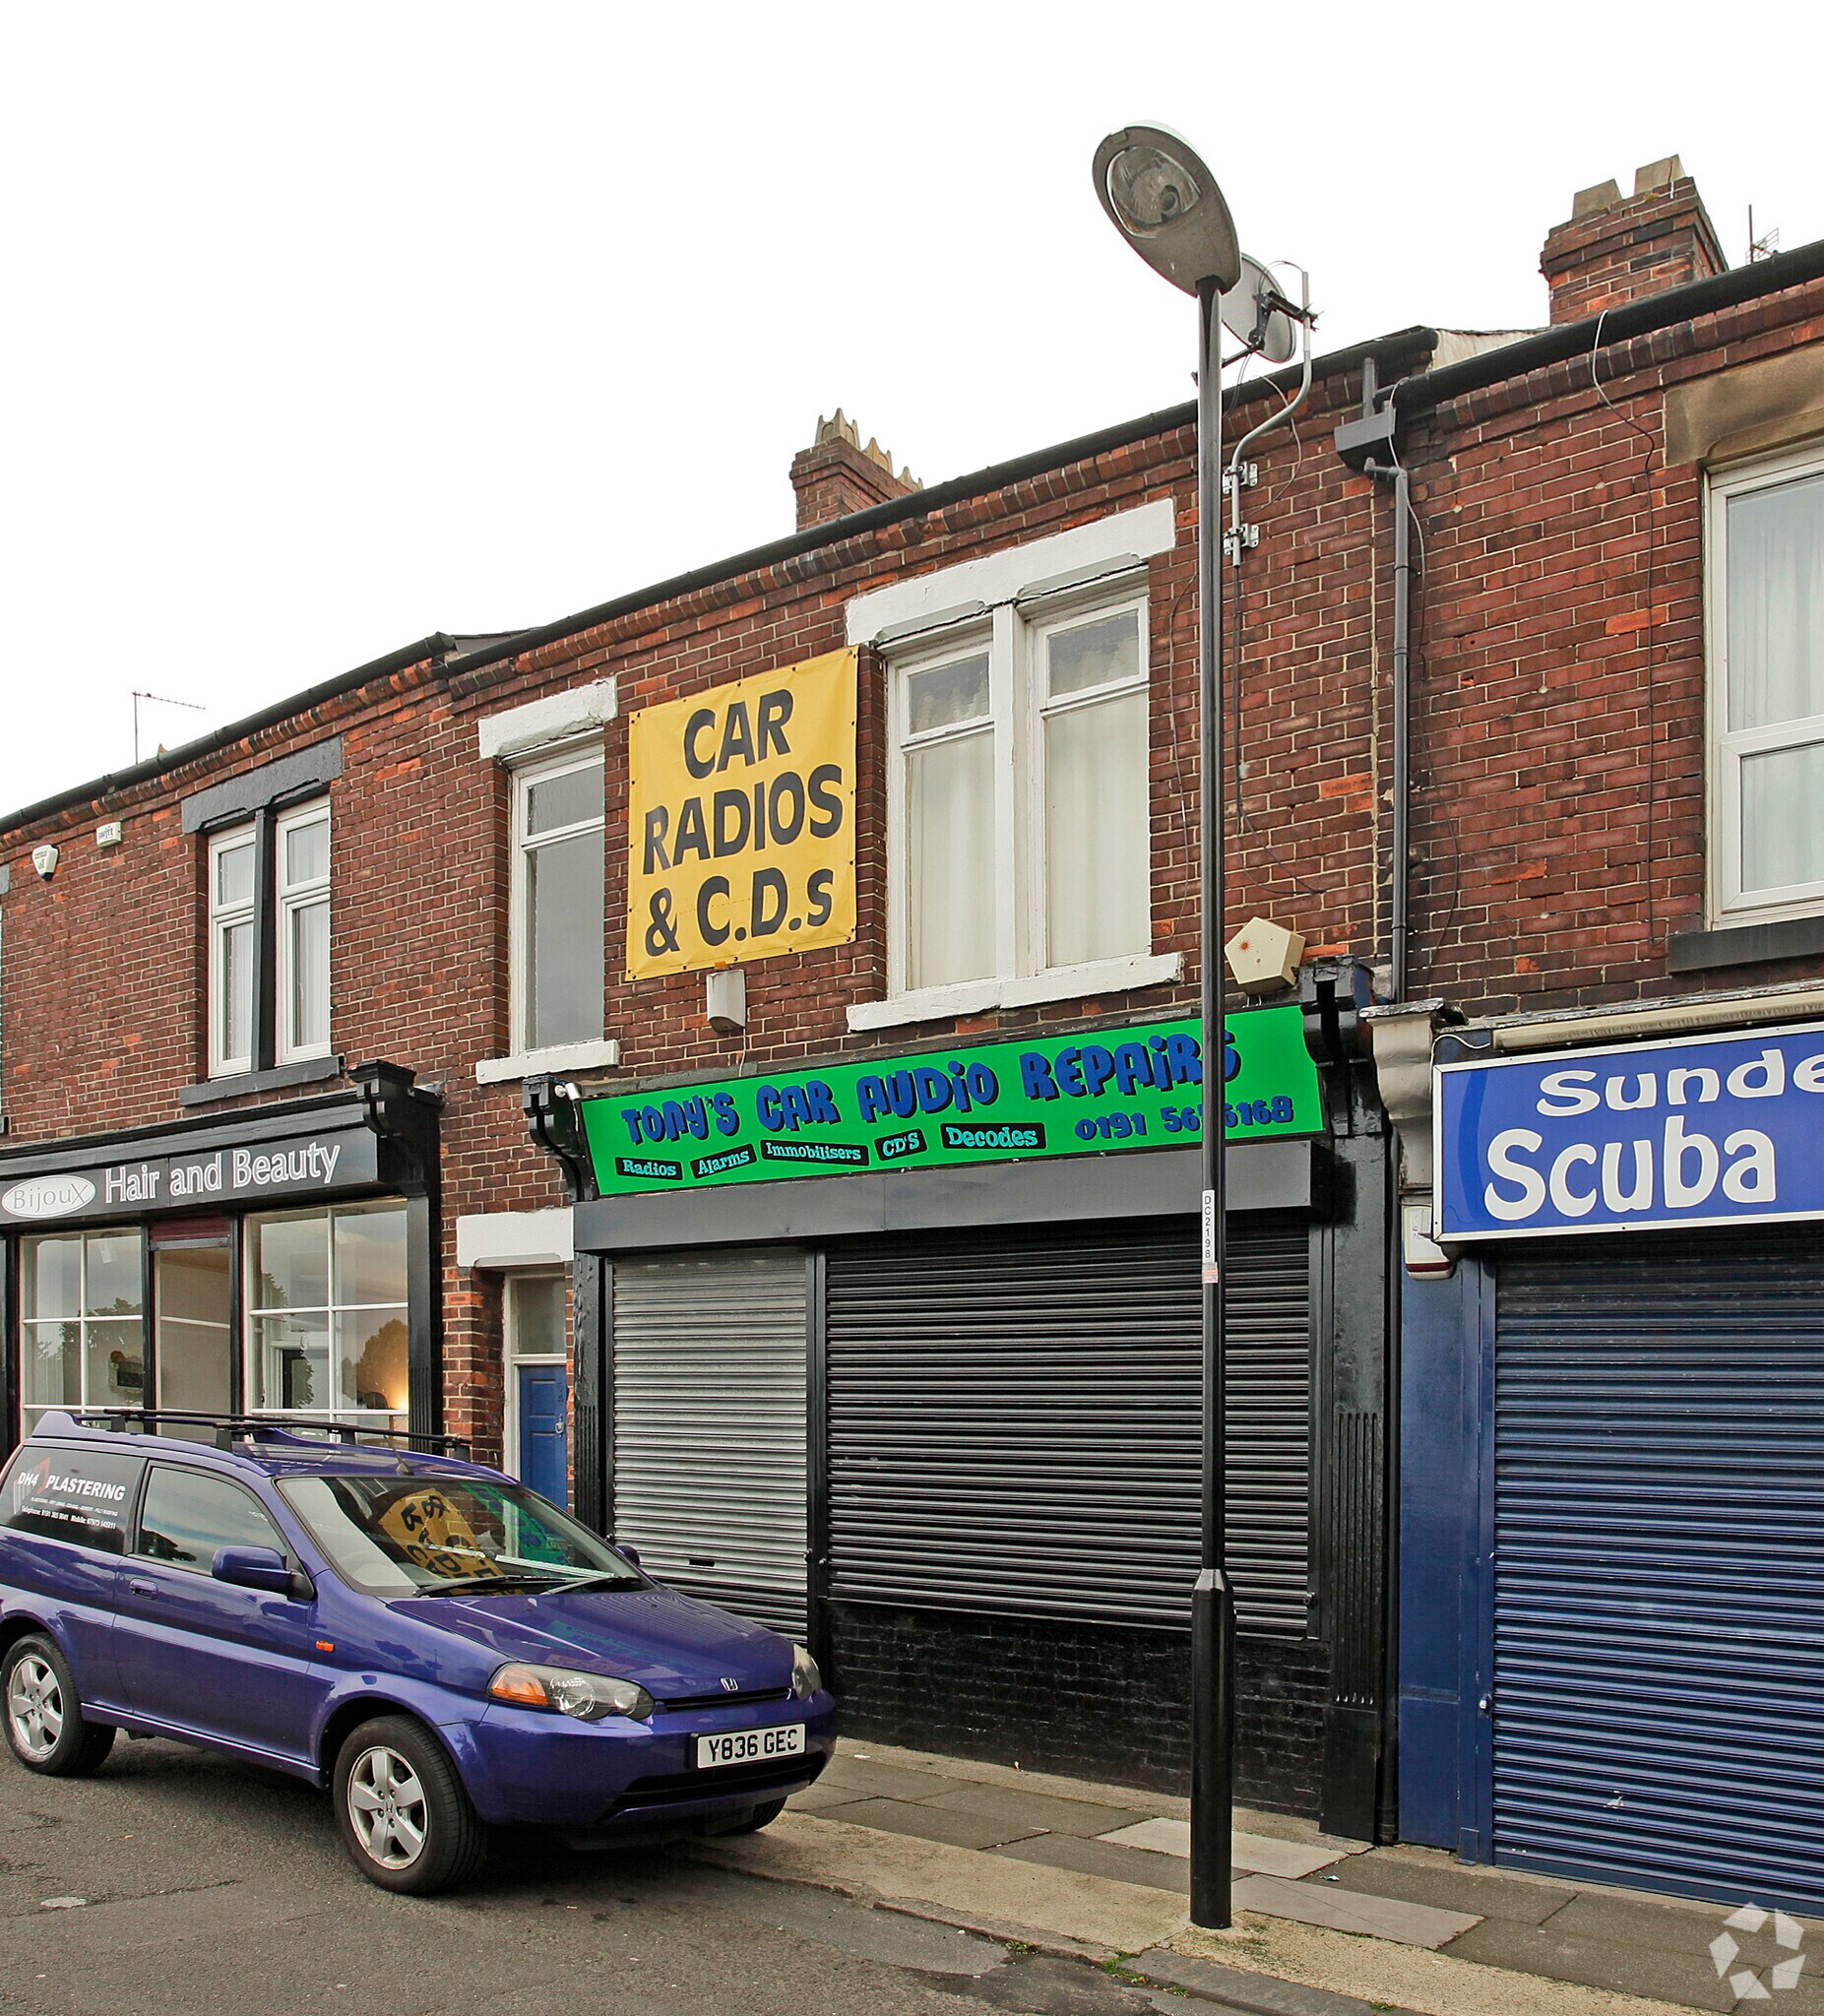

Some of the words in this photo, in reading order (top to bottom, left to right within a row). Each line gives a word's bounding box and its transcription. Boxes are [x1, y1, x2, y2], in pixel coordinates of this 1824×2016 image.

[683, 688, 794, 780] CAR
[642, 763, 844, 875] RADIOS
[645, 887, 681, 957] &
[755, 1079, 842, 1131] CAR
[1074, 1111, 1148, 1141] 0191
[1160, 1095, 1294, 1133] 566168
[765, 1141, 862, 1162] Immobilisers
[946, 1126, 1038, 1148] Decodes
[103, 1164, 160, 1204] Hair
[168, 1152, 223, 1197] and
[231, 1141, 342, 1189] Beauty
[621, 1159, 678, 1177] Radios
[697, 1149, 751, 1176] Alarms
[1483, 1114, 1777, 1221] Scuba
[1203, 1194, 1213, 1259] DC2198
[45, 1475, 126, 1501] PLASTERING
[708, 1733, 758, 1762] Y836
[764, 1729, 798, 1754] GEC
